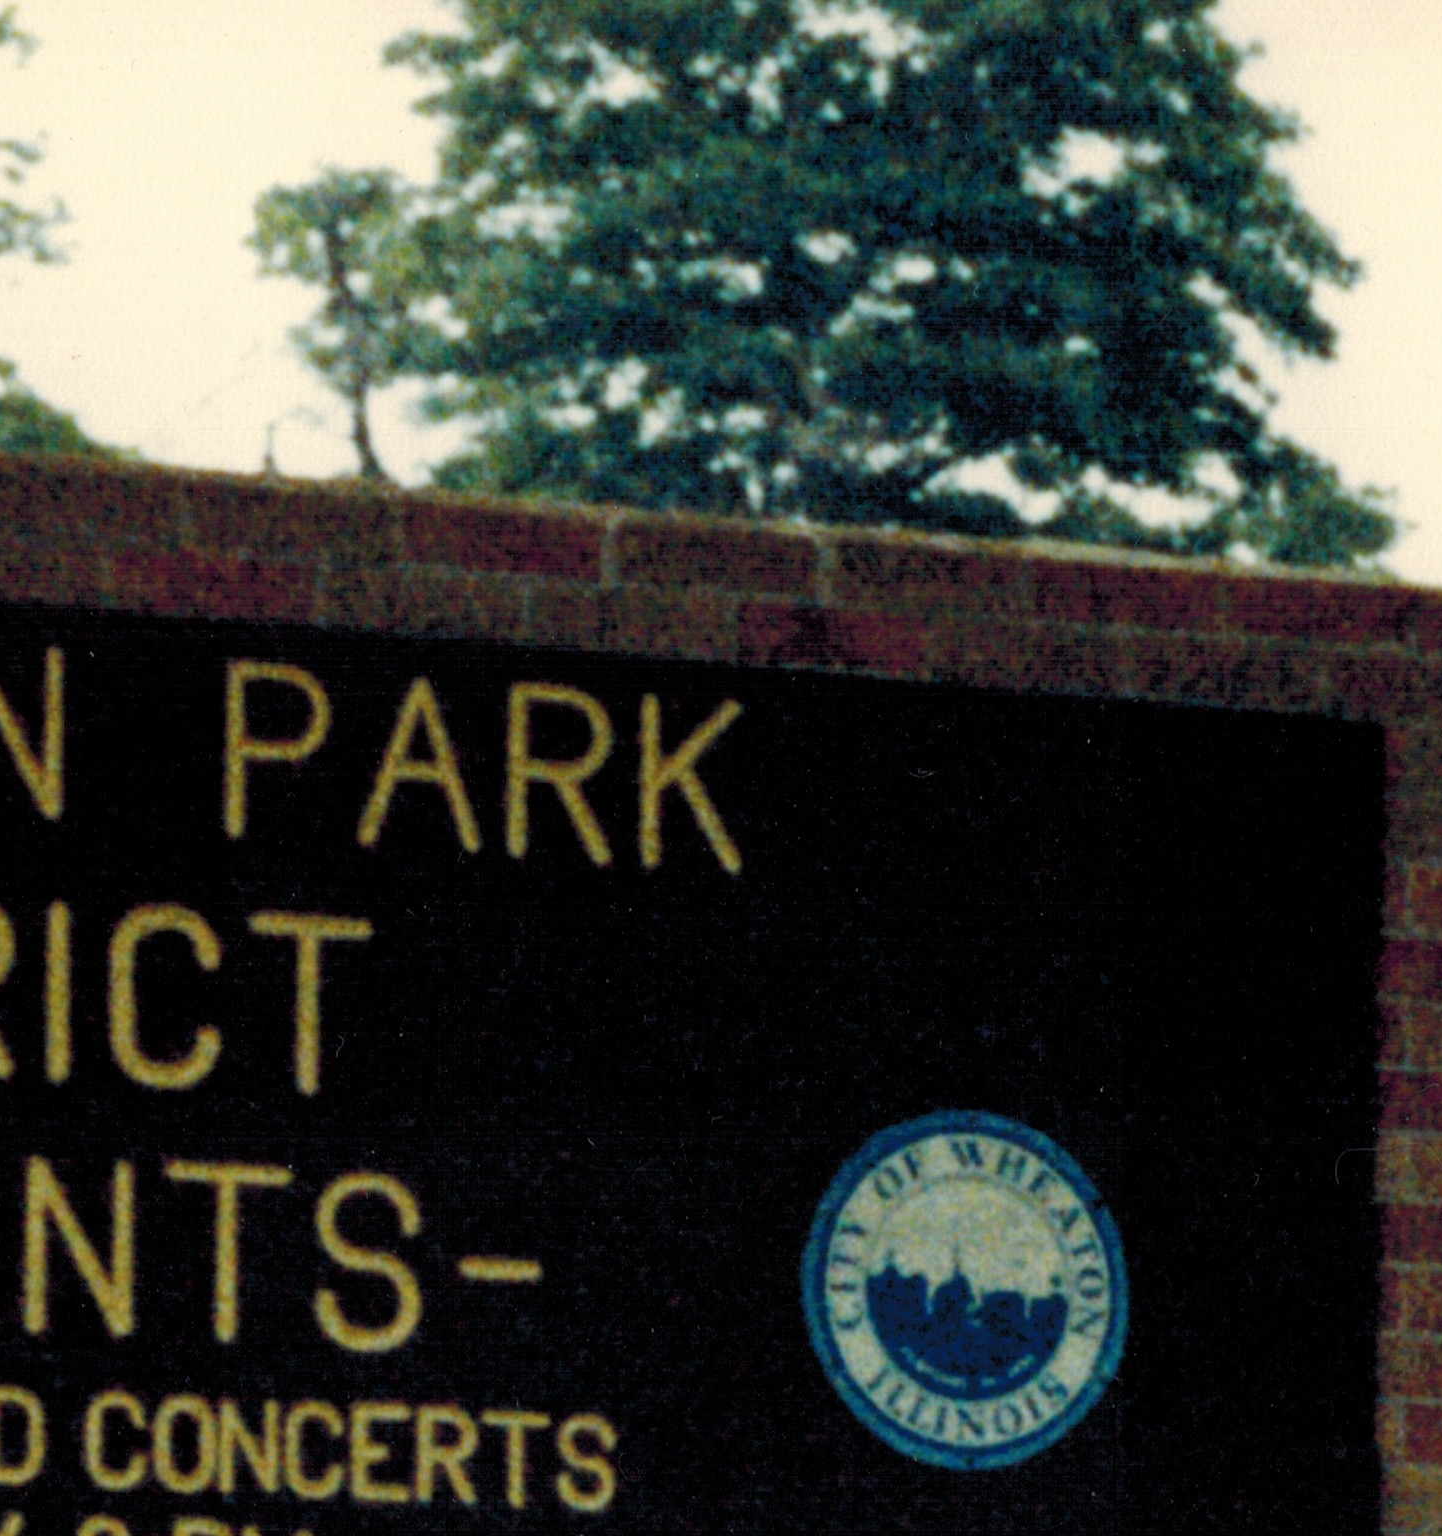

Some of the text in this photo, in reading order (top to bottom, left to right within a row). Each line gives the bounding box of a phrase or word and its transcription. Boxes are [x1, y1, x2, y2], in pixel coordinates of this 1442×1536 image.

[223, 660, 742, 873] PARK
[830, 1139, 1107, 1341] CITY OF WHEATON
[83, 1389, 618, 1513] CONCERTS
[866, 1366, 1069, 1438] ILLINOIS
